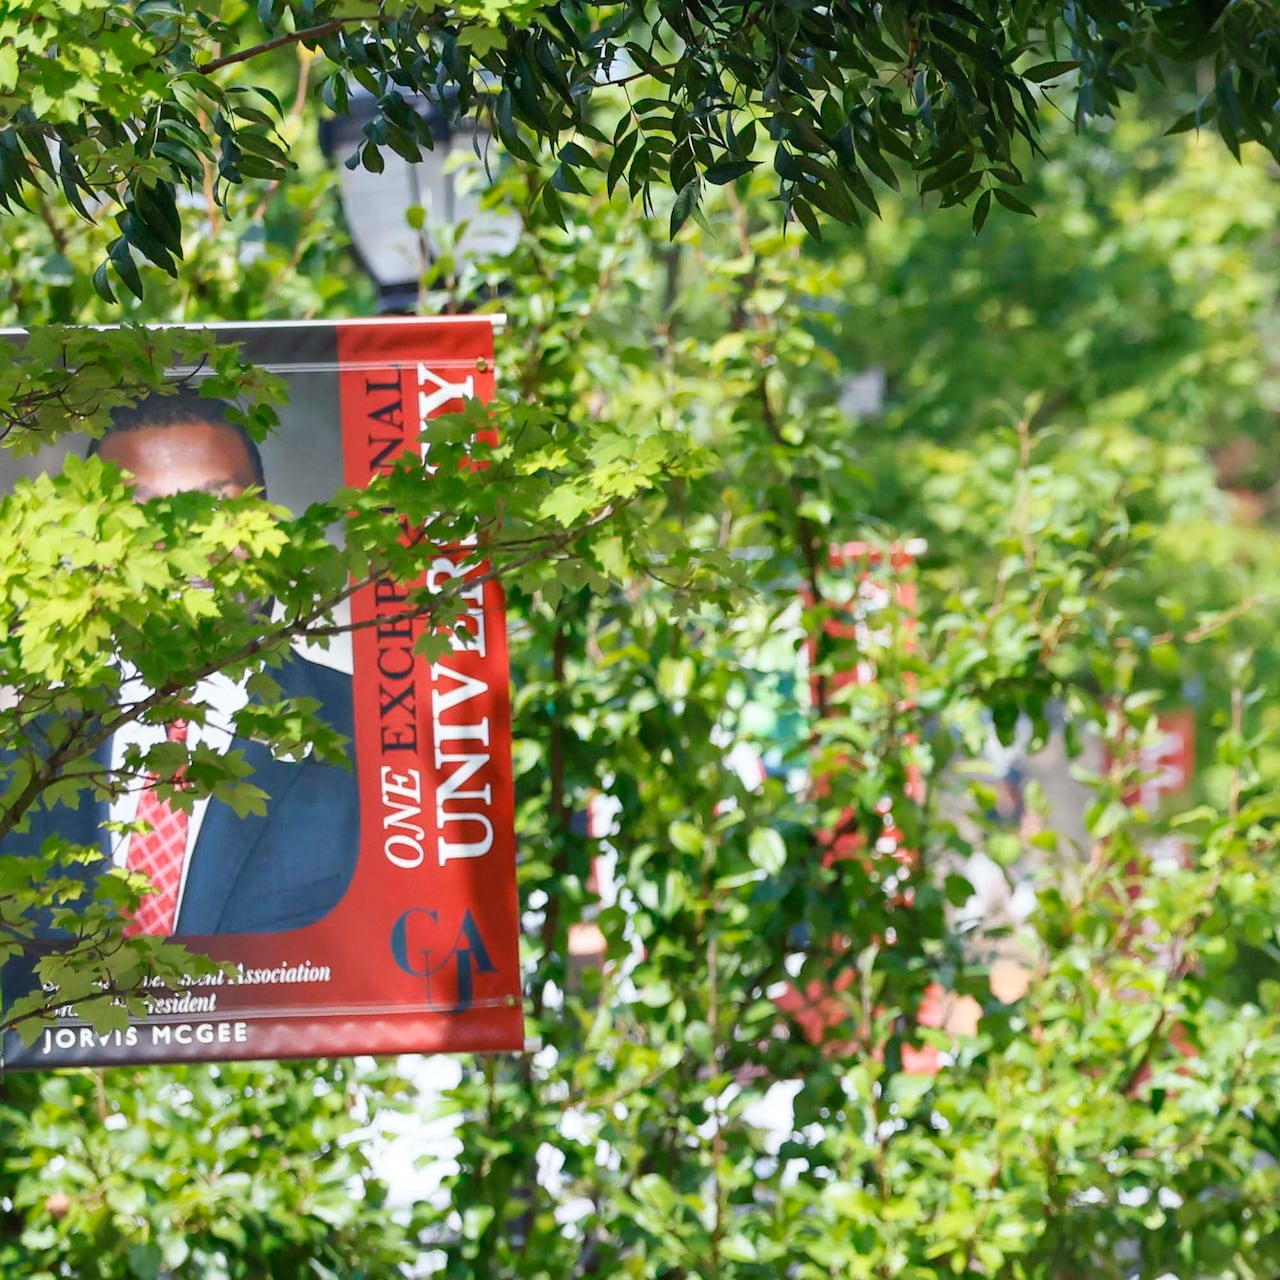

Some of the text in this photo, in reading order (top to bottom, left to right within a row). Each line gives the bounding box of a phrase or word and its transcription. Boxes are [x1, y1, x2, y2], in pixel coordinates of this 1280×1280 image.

[365, 362, 424, 869] ONE EXCEPNAL
[228, 960, 331, 986] Association
[144, 990, 217, 1015] resident
[42, 1021, 249, 1054] JORVIS MCGEE
